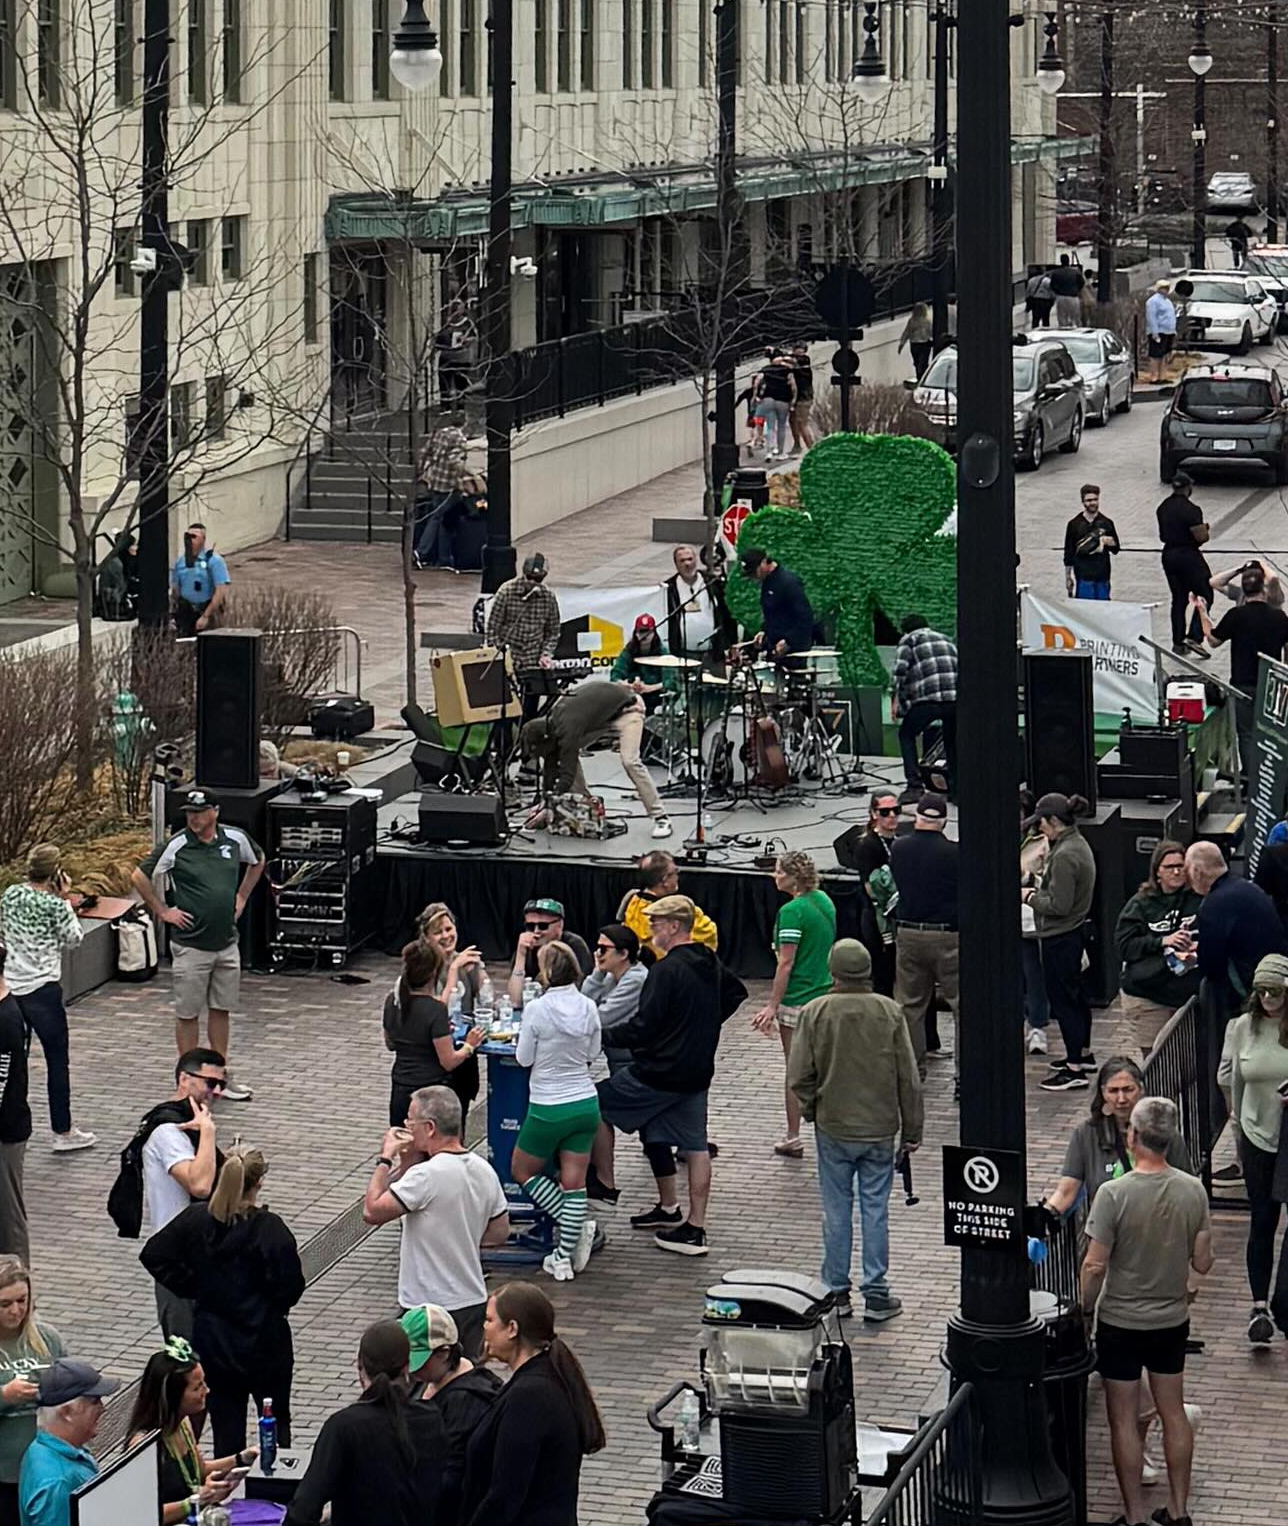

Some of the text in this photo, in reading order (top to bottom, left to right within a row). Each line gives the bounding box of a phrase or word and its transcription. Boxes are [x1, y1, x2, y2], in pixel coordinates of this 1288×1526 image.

[724, 517, 742, 534] ST
[1080, 638, 1140, 660] PRINTING
[1095, 656, 1139, 676] RTNERS
[948, 1201, 1015, 1217] NO PARKING
[957, 1213, 1008, 1228] THIS SIDE
[954, 1225, 1011, 1240] OF STREET
